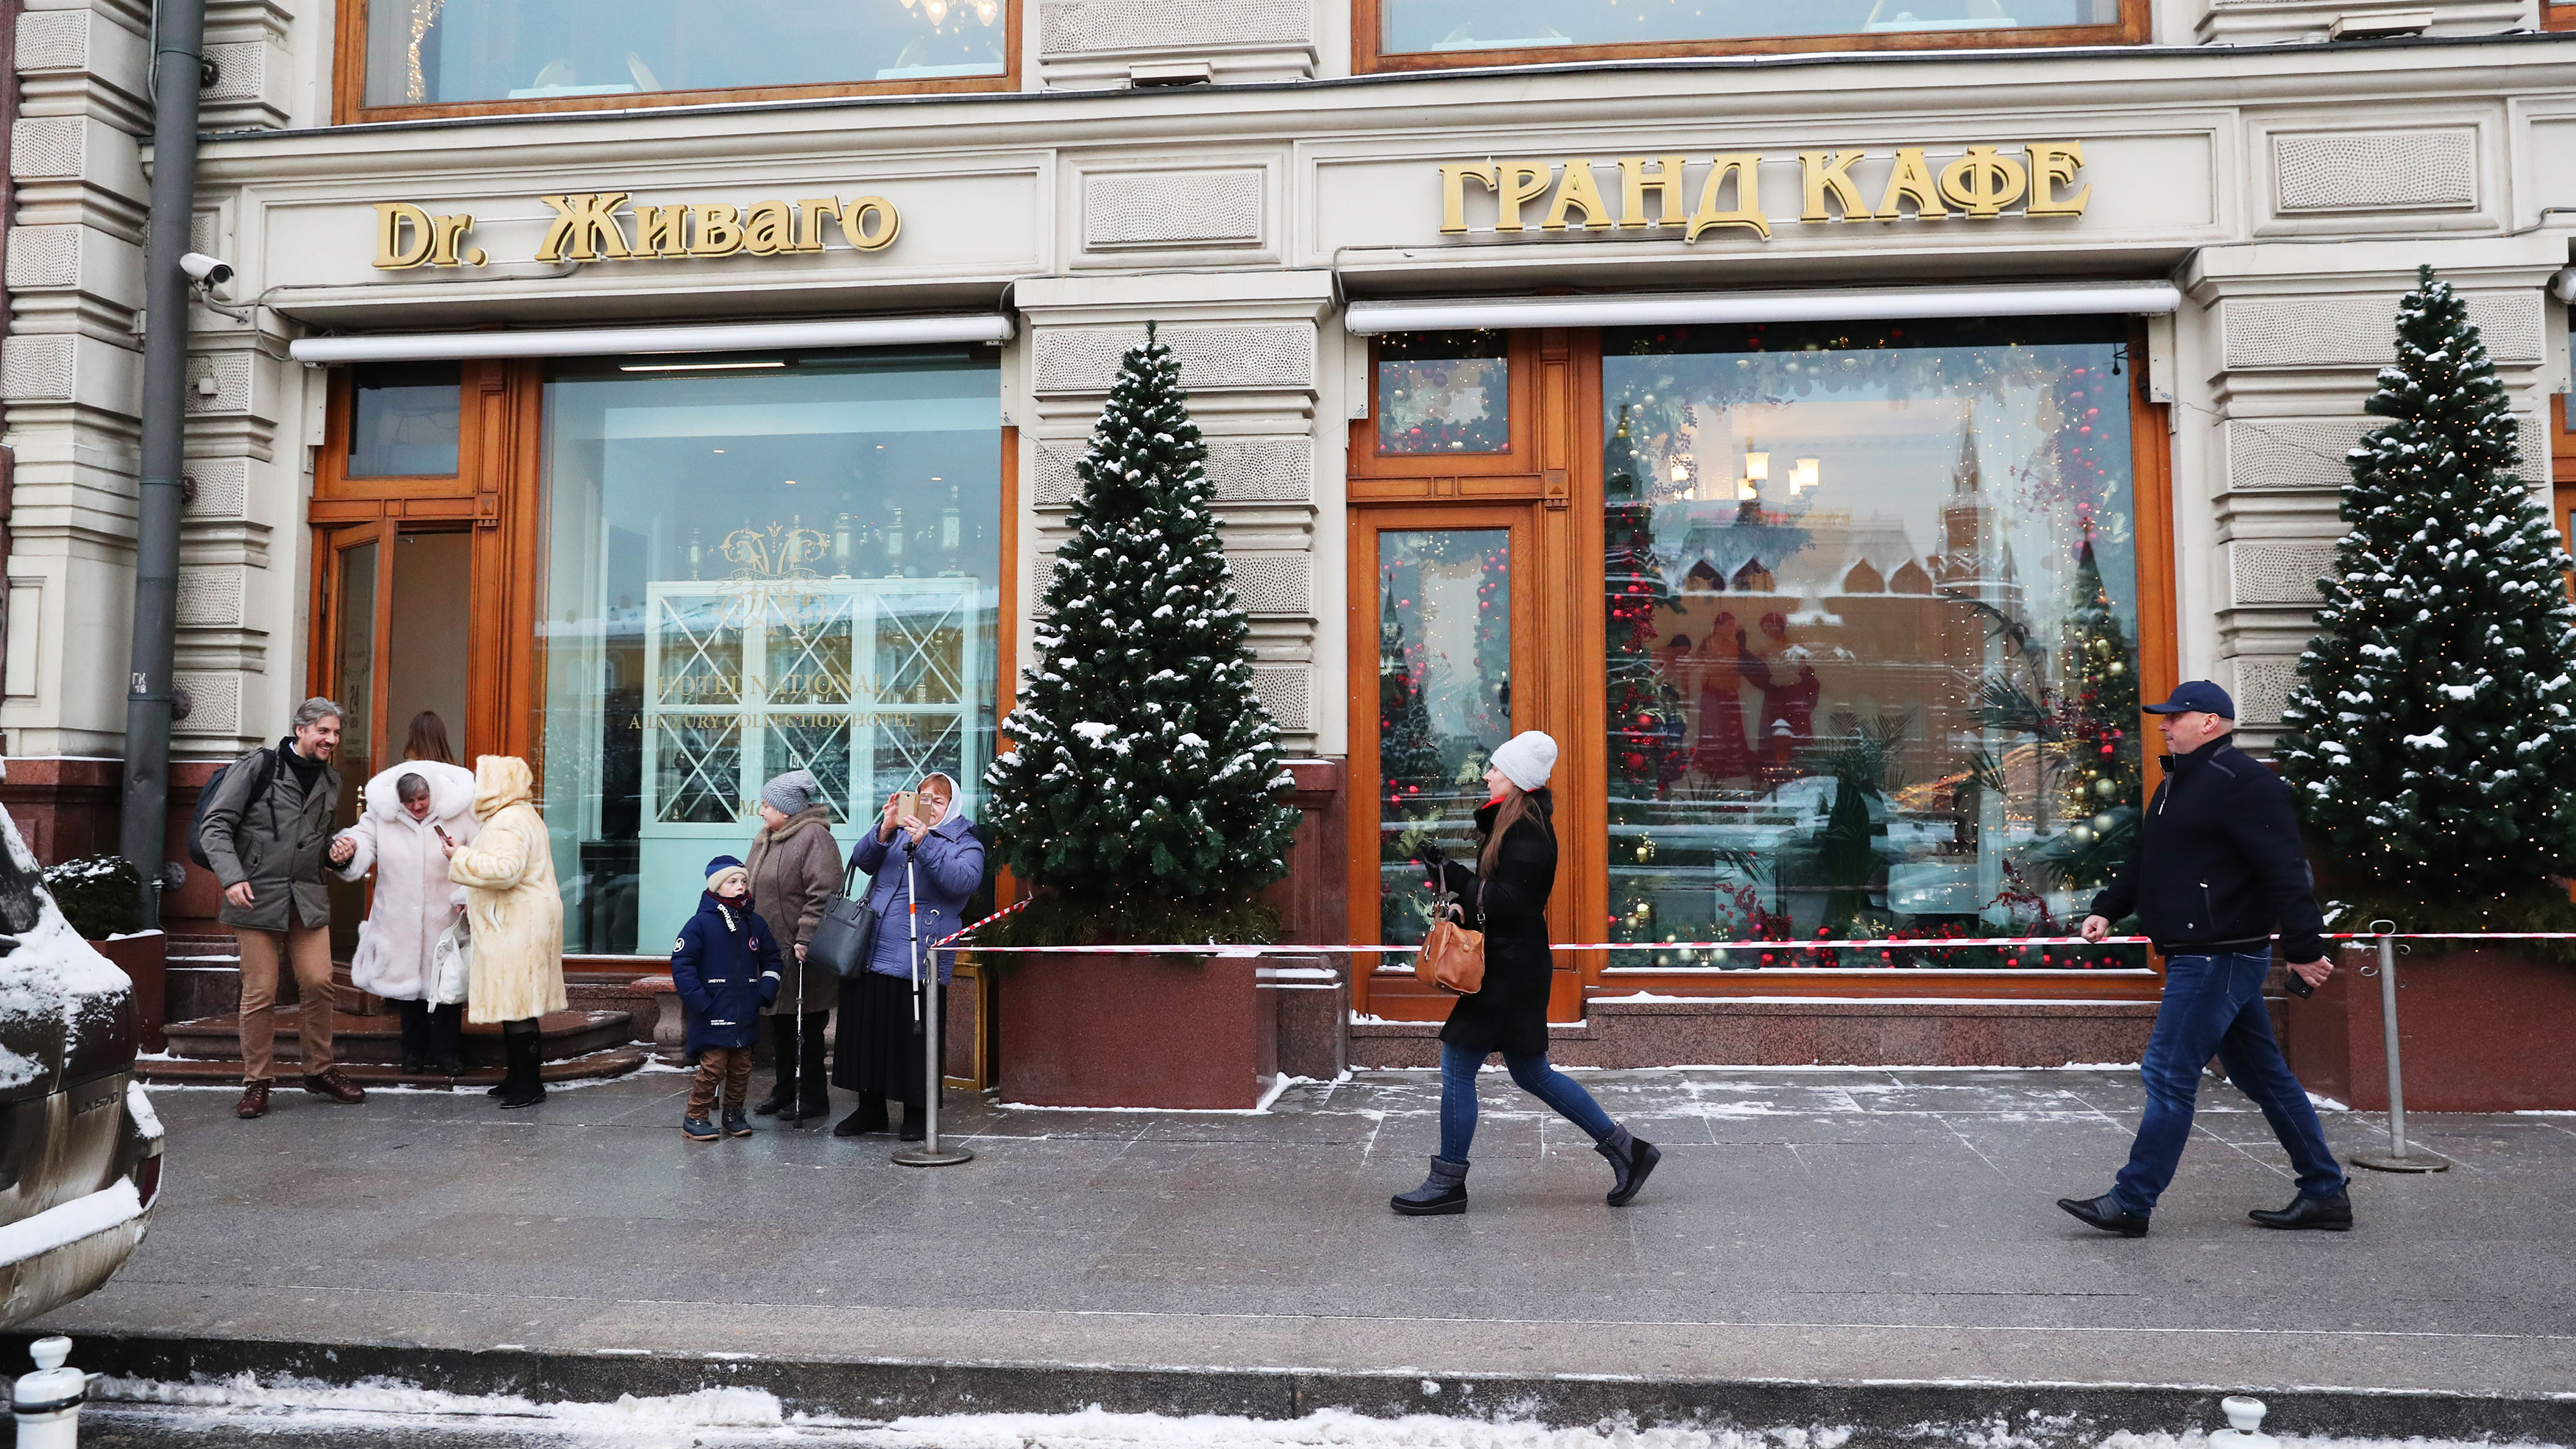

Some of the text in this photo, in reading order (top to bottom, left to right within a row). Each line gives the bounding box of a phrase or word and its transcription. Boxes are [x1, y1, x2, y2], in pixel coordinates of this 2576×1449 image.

[1437, 141, 2092, 244] ГРАНД КАФЕ
[370, 192, 902, 270] Dr. Живаго
[134, 684, 147, 693] 18
[657, 673, 886, 695] HOTEL NATIONAL
[629, 712, 915, 729] A LUXURY COLLECTION HOTEL
